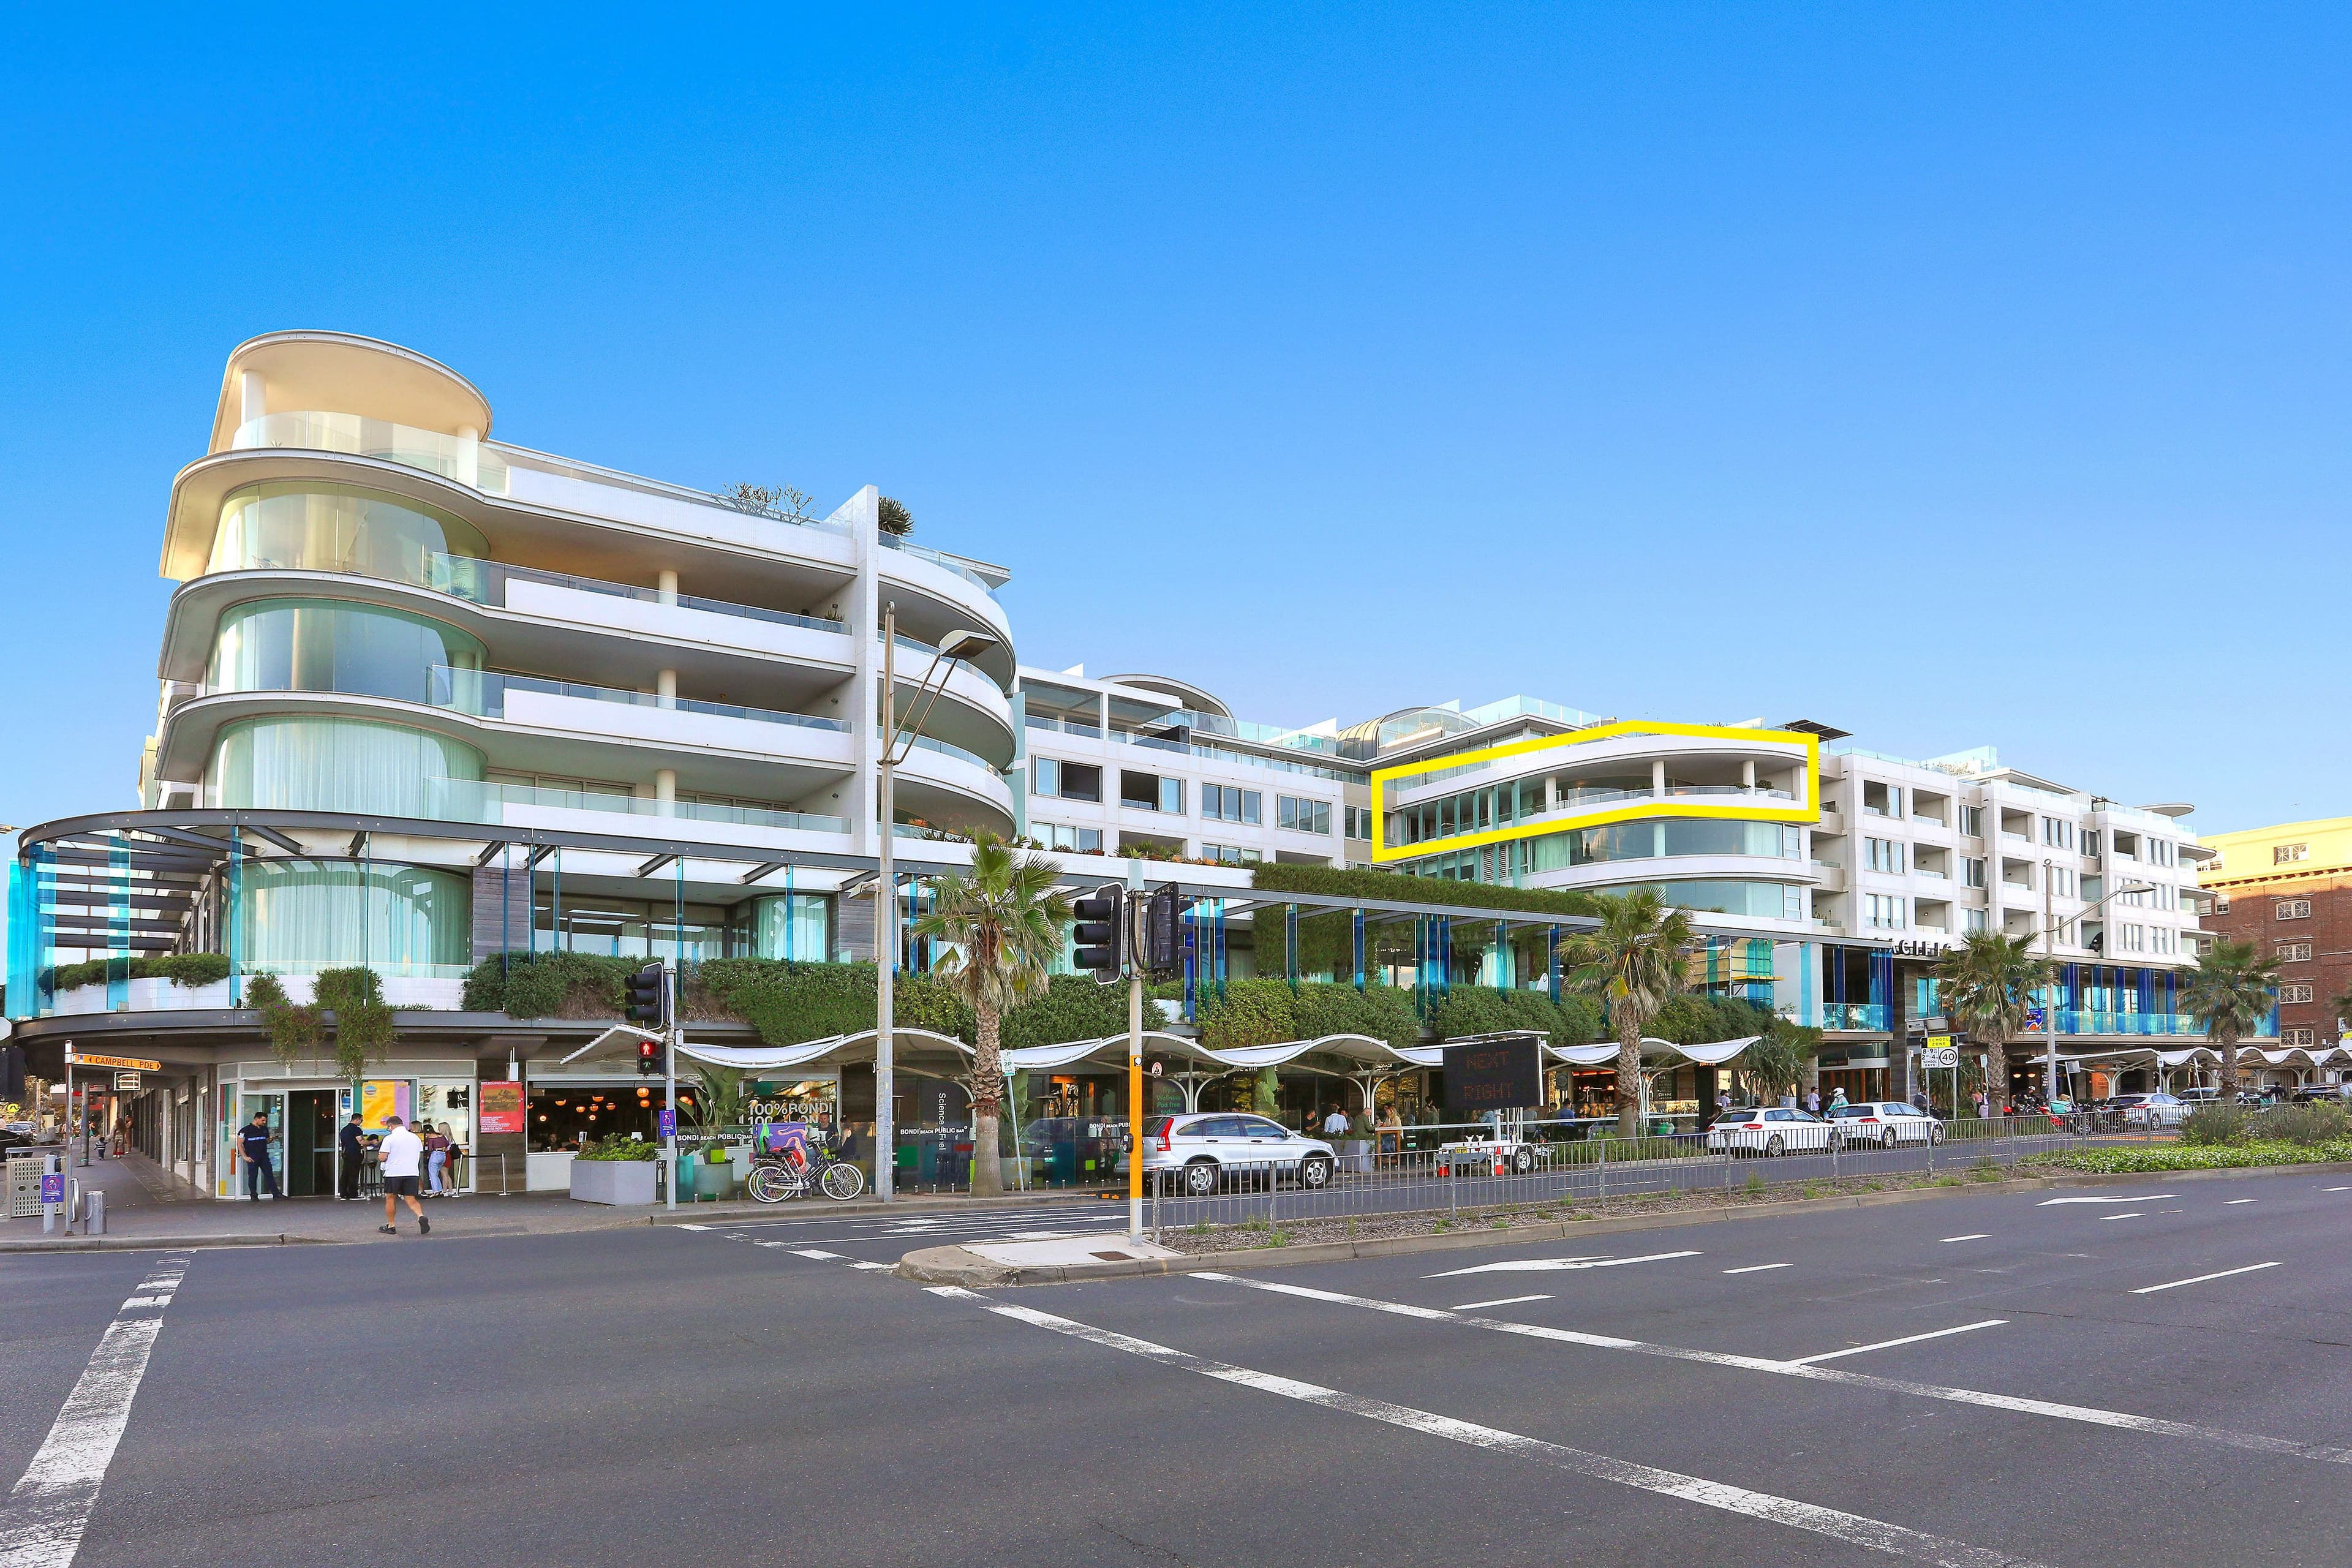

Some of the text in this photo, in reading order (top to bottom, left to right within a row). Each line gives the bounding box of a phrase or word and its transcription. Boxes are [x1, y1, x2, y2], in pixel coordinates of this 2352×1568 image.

[96, 1057, 154, 1069] CAMPBELL PDE
[1466, 1050, 1509, 1069] NEXT
[1463, 1083, 1513, 1100] RIGHT
